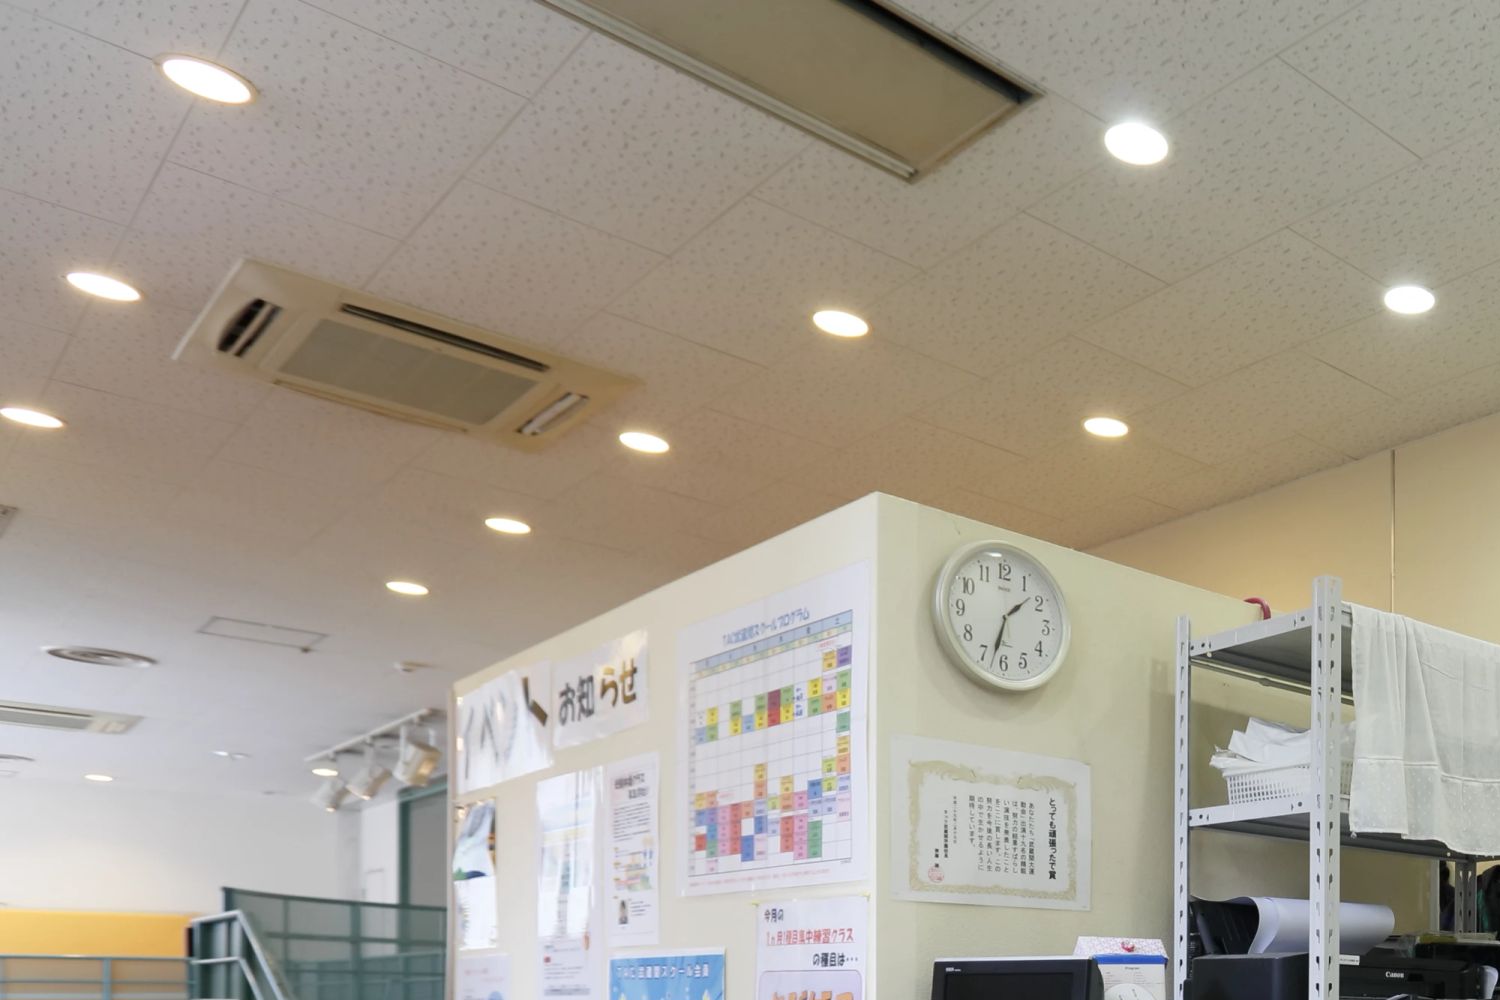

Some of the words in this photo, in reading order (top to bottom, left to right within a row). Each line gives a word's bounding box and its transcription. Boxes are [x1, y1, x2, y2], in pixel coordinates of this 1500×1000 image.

[980, 564, 989, 582] 11
[998, 563, 1011, 581] 12
[962, 577, 975, 595] 10
[1022, 575, 1026, 592] 1
[956, 598, 965, 616] 9
[1034, 595, 1044, 612] 2
[963, 624, 973, 641] 8
[1042, 619, 1050, 636] 3
[980, 644, 988, 661] 7
[1034, 640, 1043, 657] 4
[999, 655, 1008, 671] 6
[1018, 652, 1028, 669] 5
[559, 658, 638, 727] お知らせ
[1048, 797, 1057, 880] とっても頑張ったで賞
[764, 908, 784, 923] 今月の
[1385, 971, 1404, 979] Canon
